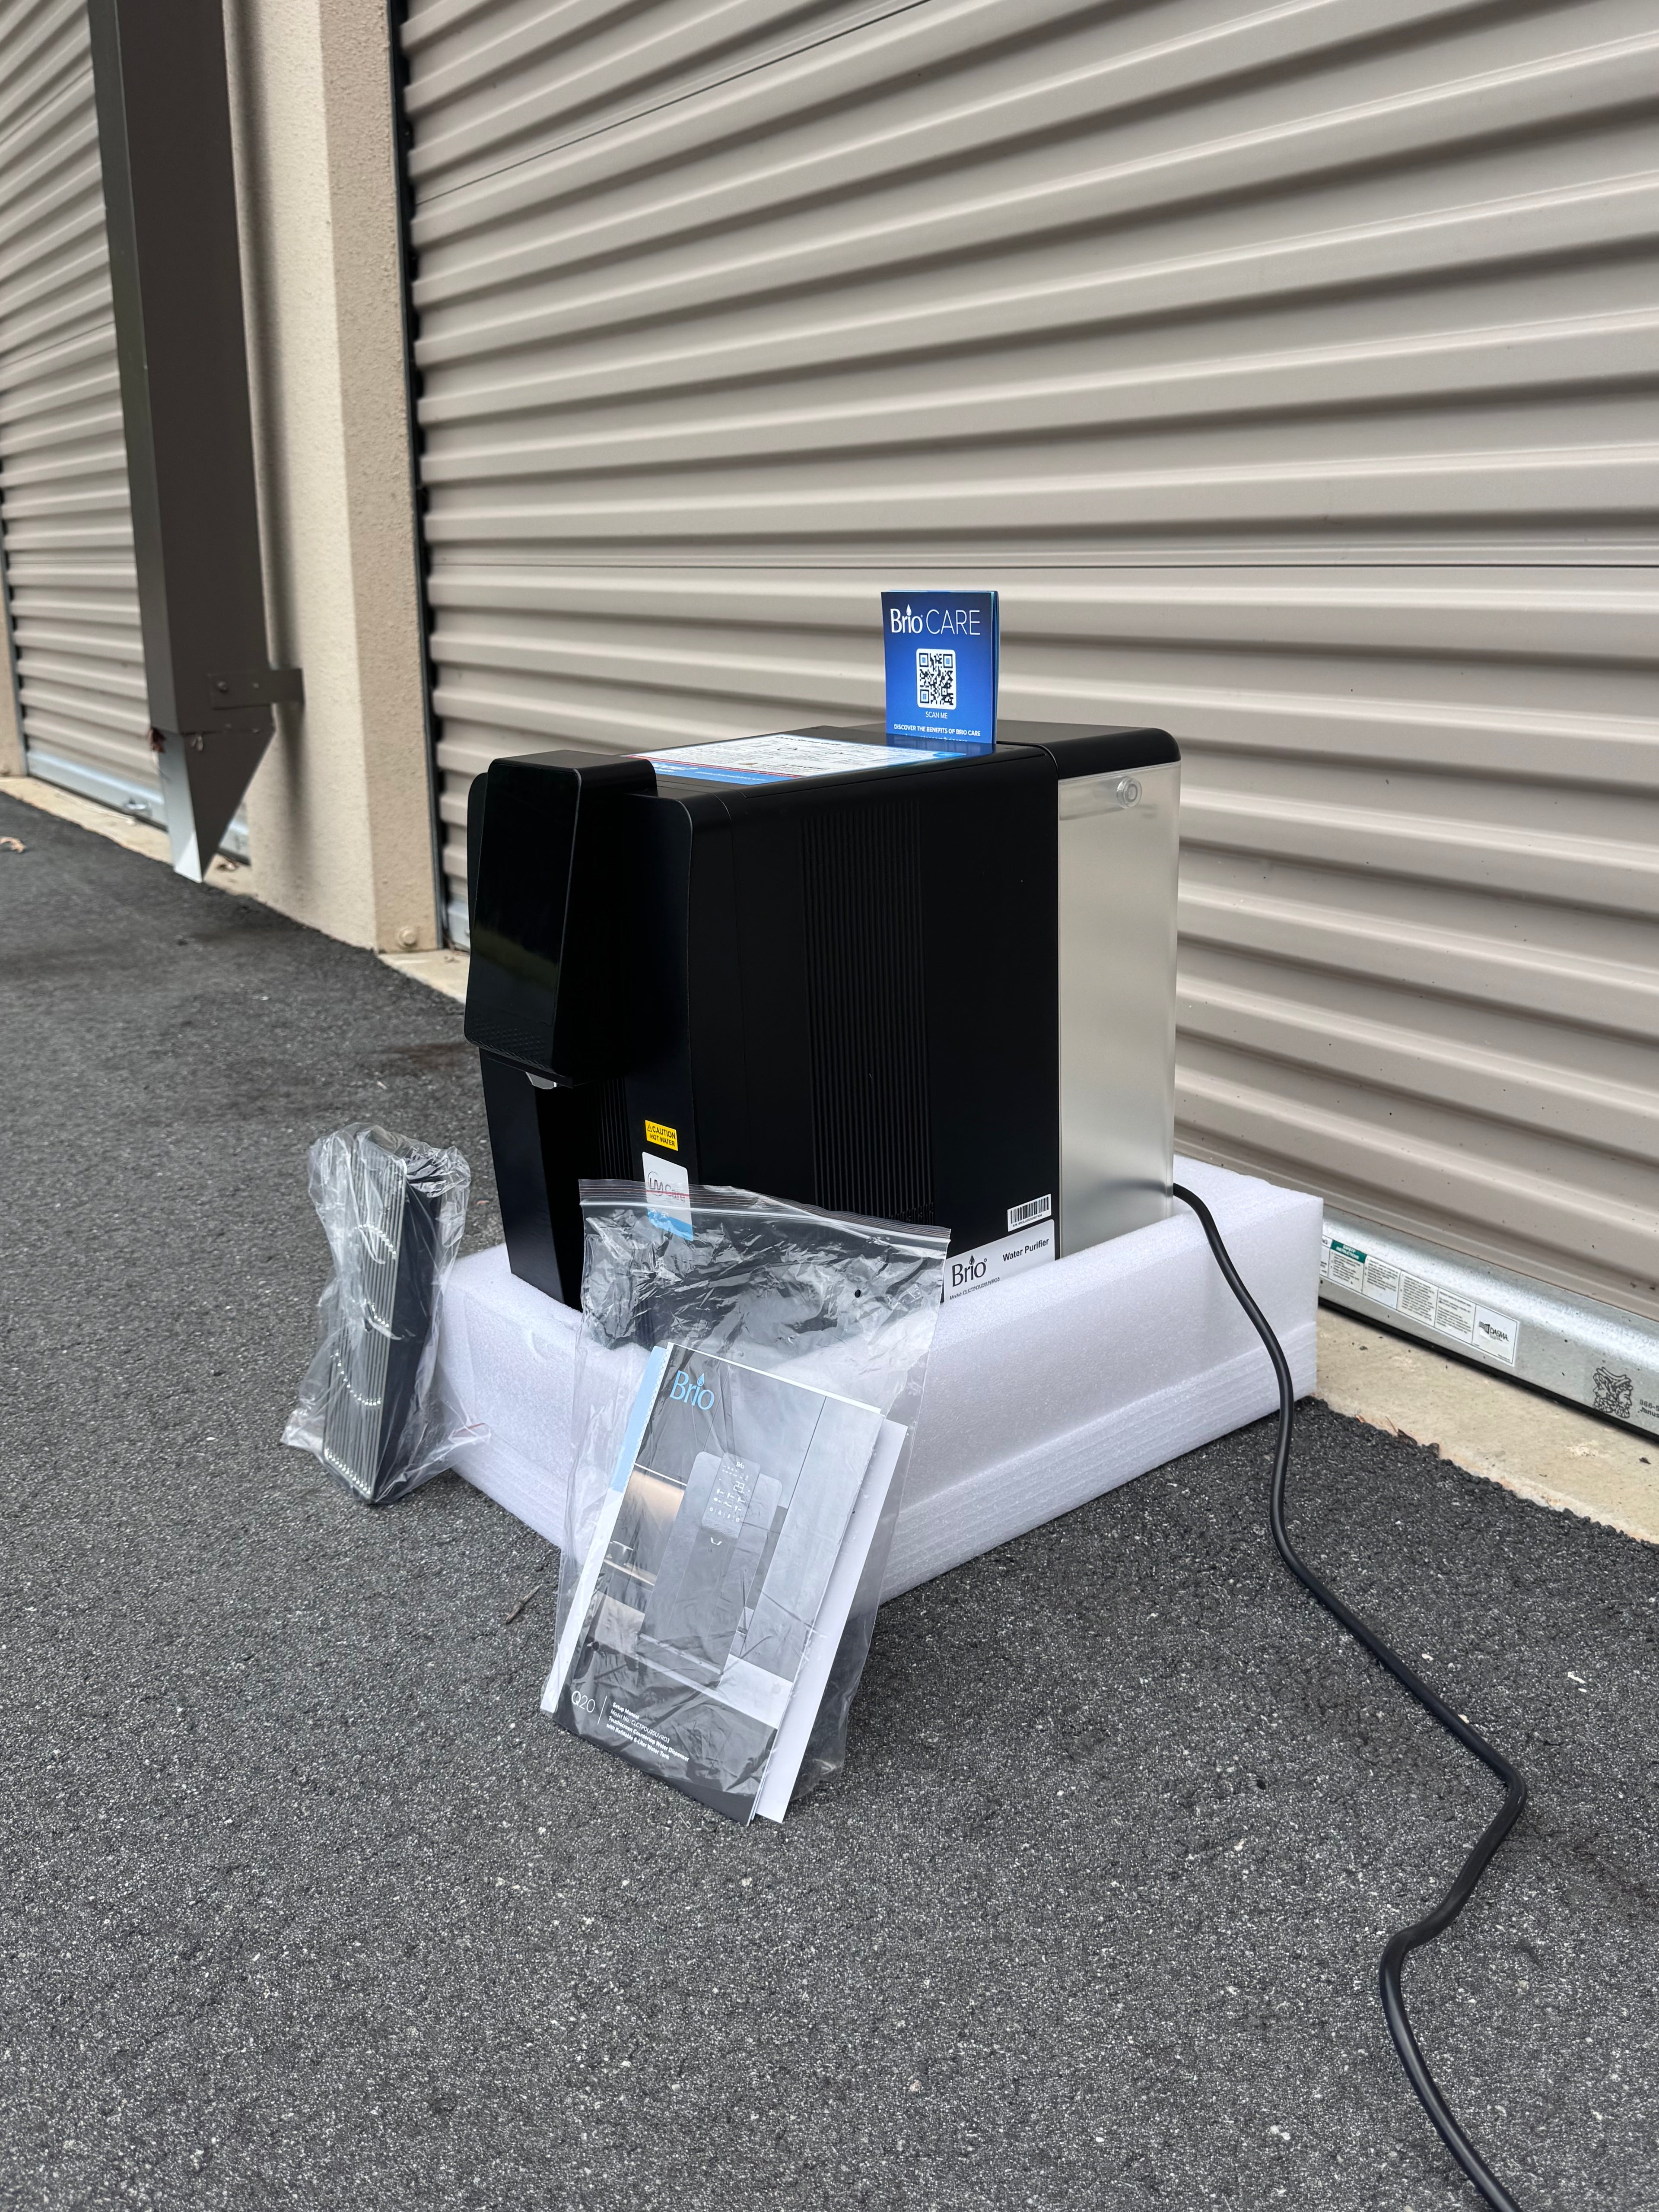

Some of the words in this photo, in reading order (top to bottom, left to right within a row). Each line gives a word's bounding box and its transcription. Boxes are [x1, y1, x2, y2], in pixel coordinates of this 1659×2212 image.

[890, 604, 923, 634] Brio
[926, 609, 980, 635] CARE
[652, 1126, 676, 1139] CAUTION
[660, 1137, 675, 1147] WATER
[952, 1254, 987, 1287] Brio
[1002, 1249, 1023, 1262] Water
[1024, 1239, 1049, 1254] Purifier
[669, 1370, 715, 1410] Brio
[571, 1690, 596, 1713] Q20
[610, 1709, 623, 1719] Model
[612, 1702, 625, 1712] Setup
[624, 1708, 640, 1720] Manual
[608, 1716, 633, 1733] Touchscreen
[633, 1729, 656, 1745] Countertop
[656, 1740, 668, 1751] Water
[668, 1747, 690, 1762] Dispenser
[615, 1727, 634, 1741] Refillable
[647, 1744, 660, 1754] Water
[660, 1751, 670, 1760] Tank
